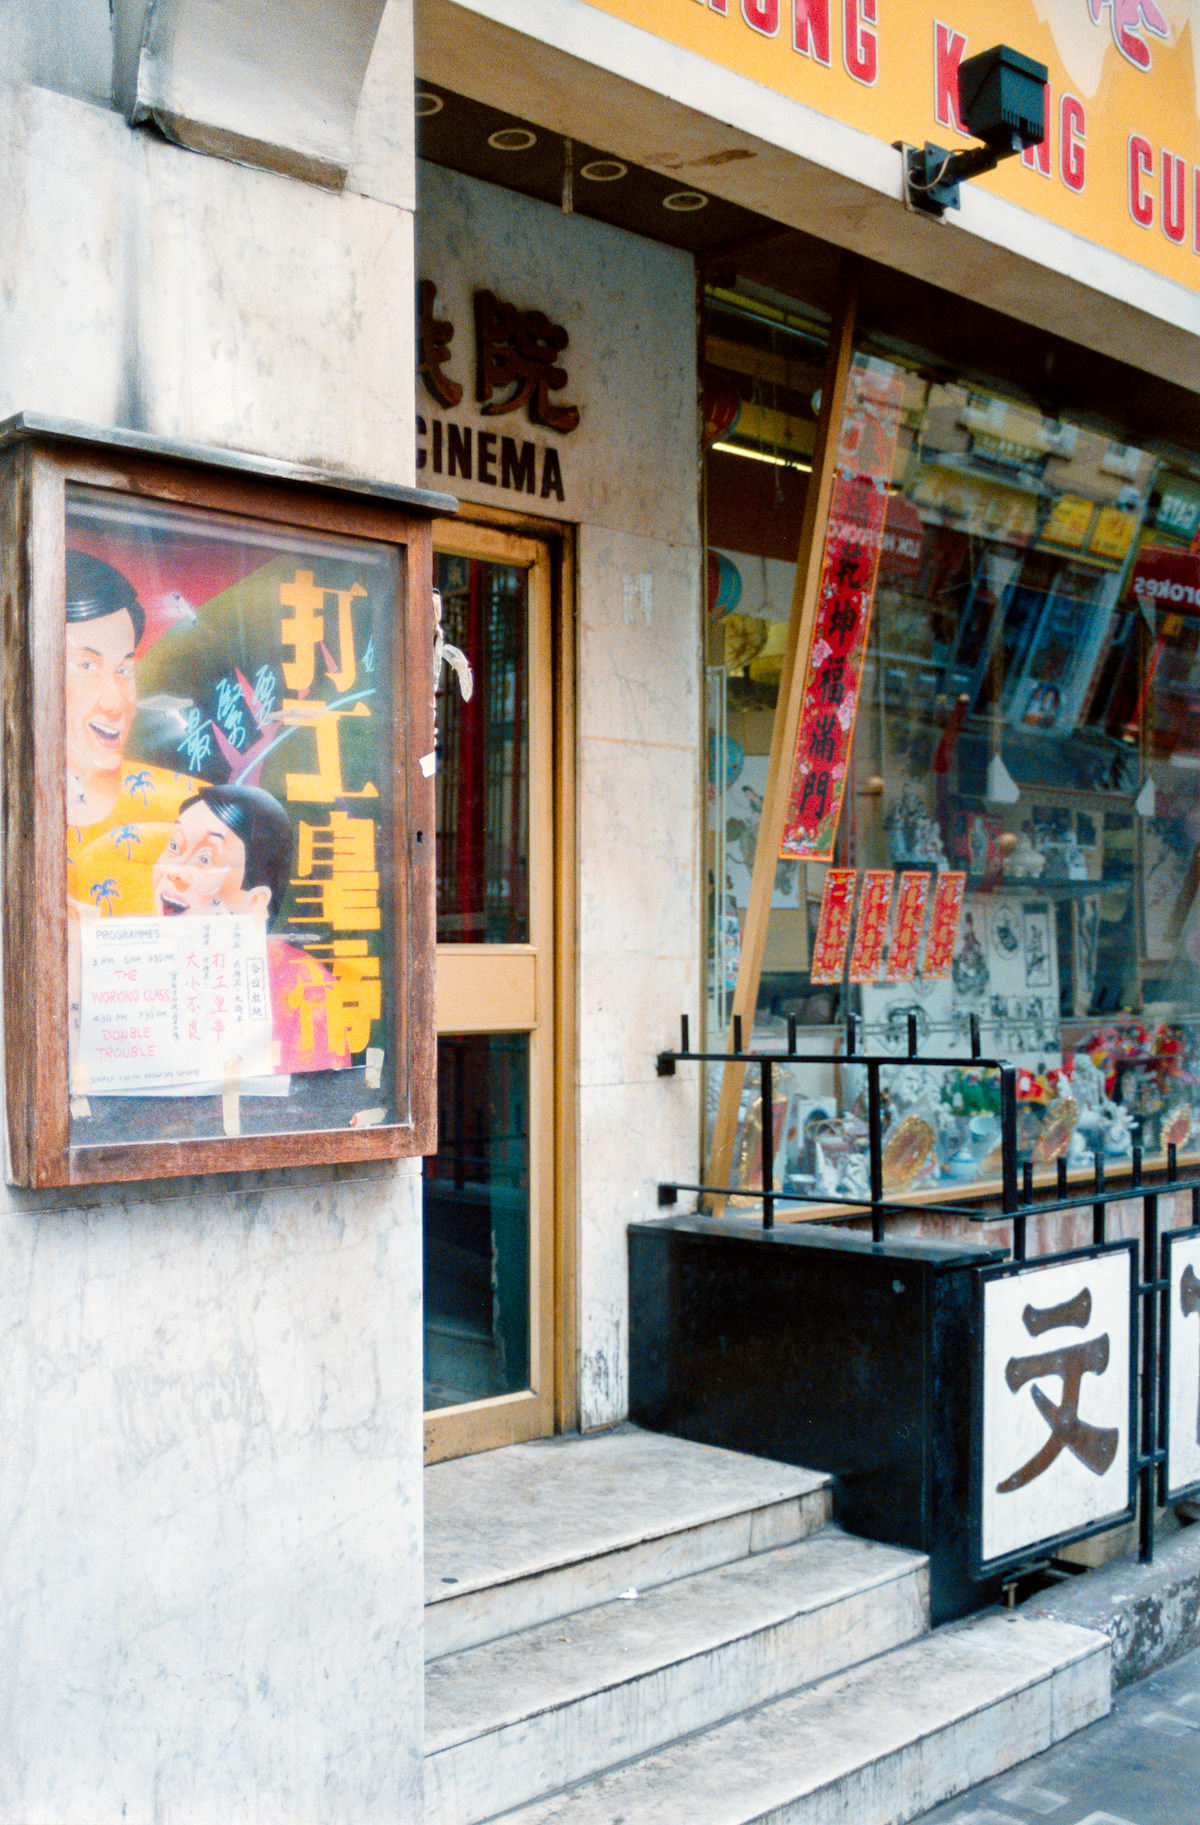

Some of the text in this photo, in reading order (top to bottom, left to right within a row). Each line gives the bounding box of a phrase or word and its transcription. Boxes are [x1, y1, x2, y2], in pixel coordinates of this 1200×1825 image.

[279, 569, 382, 1062] 打工皇帝
[96, 928, 160, 941] PROGRAMMES
[114, 969, 138, 981] THE
[91, 987, 171, 1004] WORKING CLASS
[211, 952, 229, 1044] 打工皇帝
[101, 1027, 151, 1041] DOUBLE
[96, 1045, 156, 1059] TROUBLE
[996, 1286, 1119, 1494] 文
